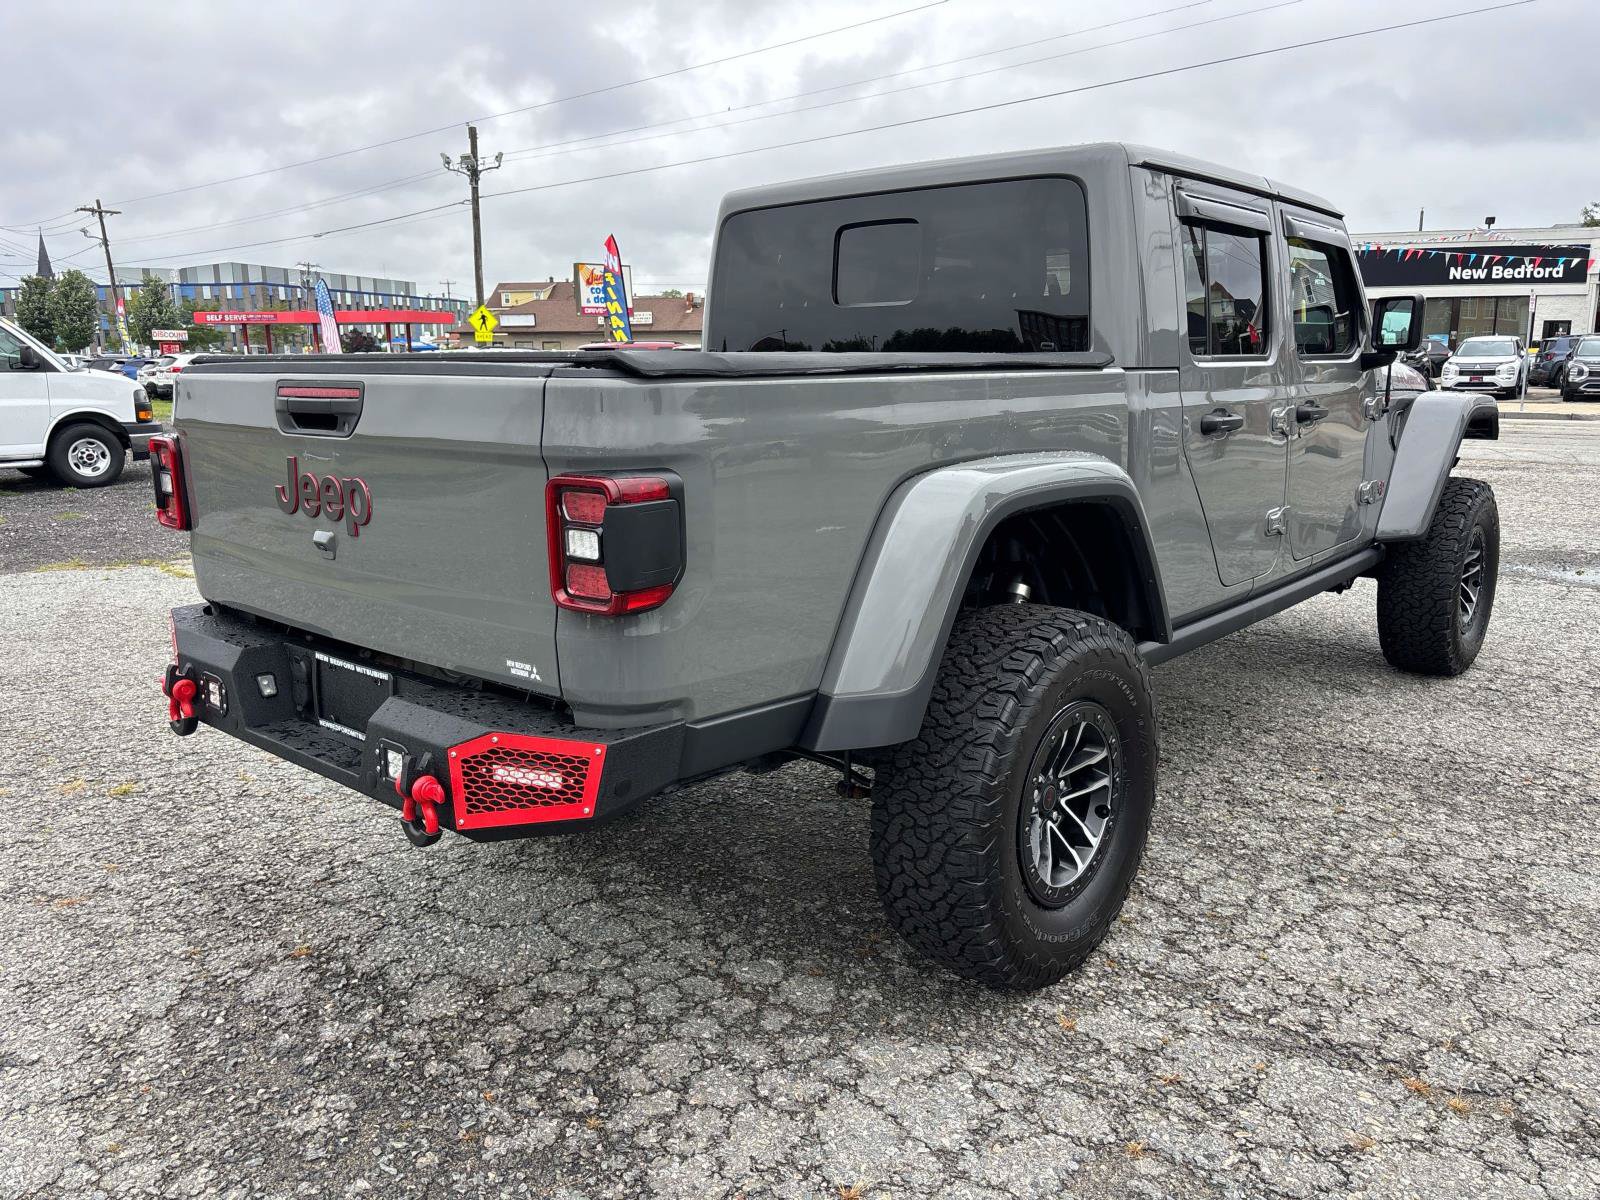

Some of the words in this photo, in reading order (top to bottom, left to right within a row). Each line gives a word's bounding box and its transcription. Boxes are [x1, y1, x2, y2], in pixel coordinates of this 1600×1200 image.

[1449, 266, 1488, 280] New
[1491, 264, 1564, 279] Bedford
[152, 331, 187, 339] DISCOUNT
[274, 456, 373, 537] Jeep
[315, 652, 329, 662] NEW
[329, 657, 355, 671] BEDFORD
[355, 665, 389, 681] MITSUBISHI
